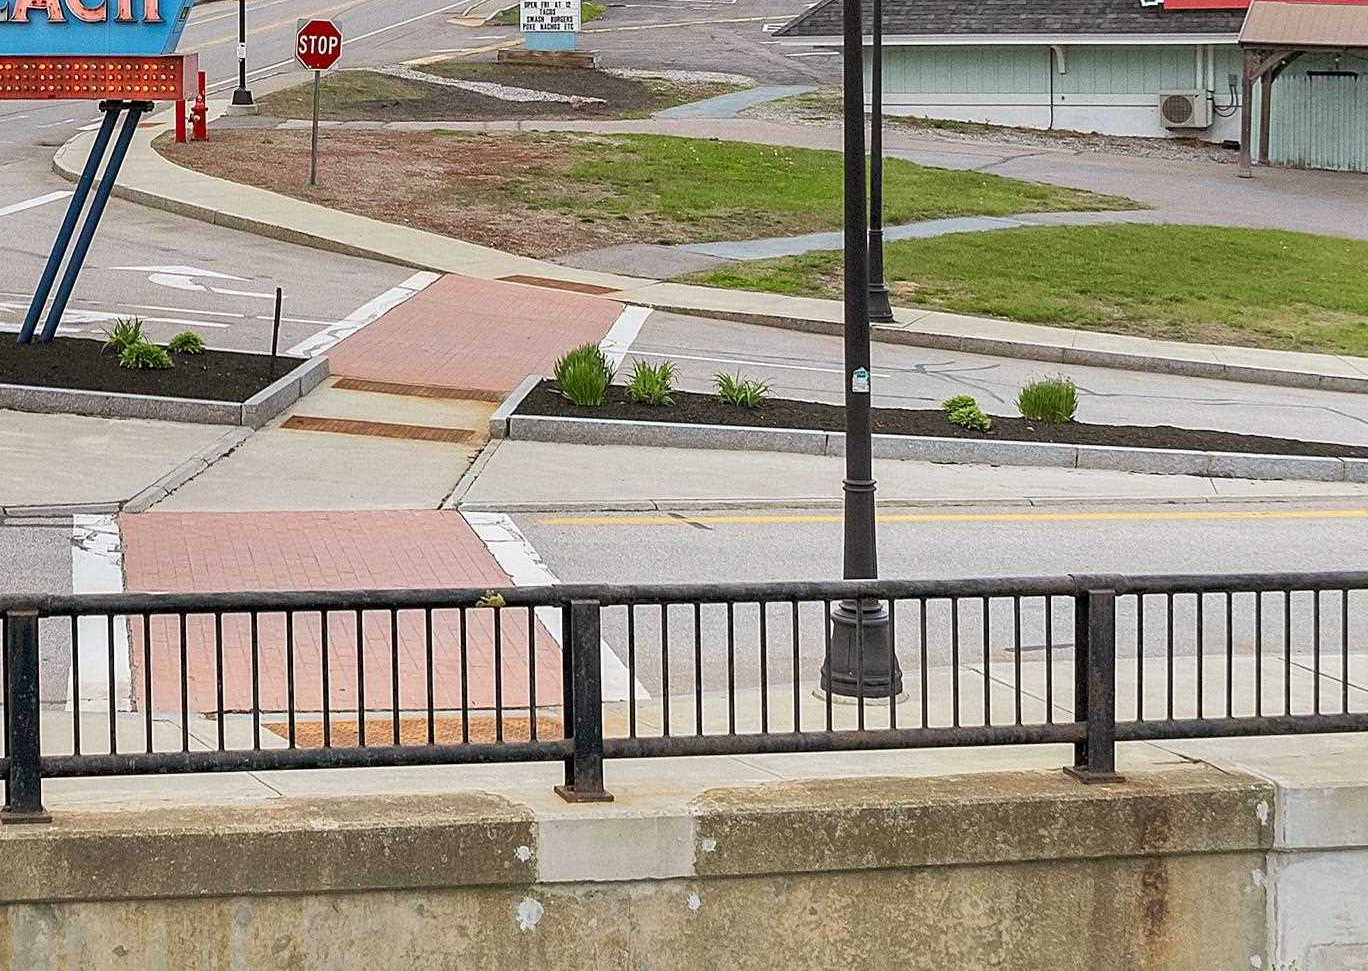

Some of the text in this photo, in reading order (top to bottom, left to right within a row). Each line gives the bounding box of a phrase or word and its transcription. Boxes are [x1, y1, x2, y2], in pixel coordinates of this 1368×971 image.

[524, 1, 538, 9] OPEN
[541, 1, 550, 9] FRI
[554, 1, 561, 9] AT
[298, 35, 338, 55] STOP
